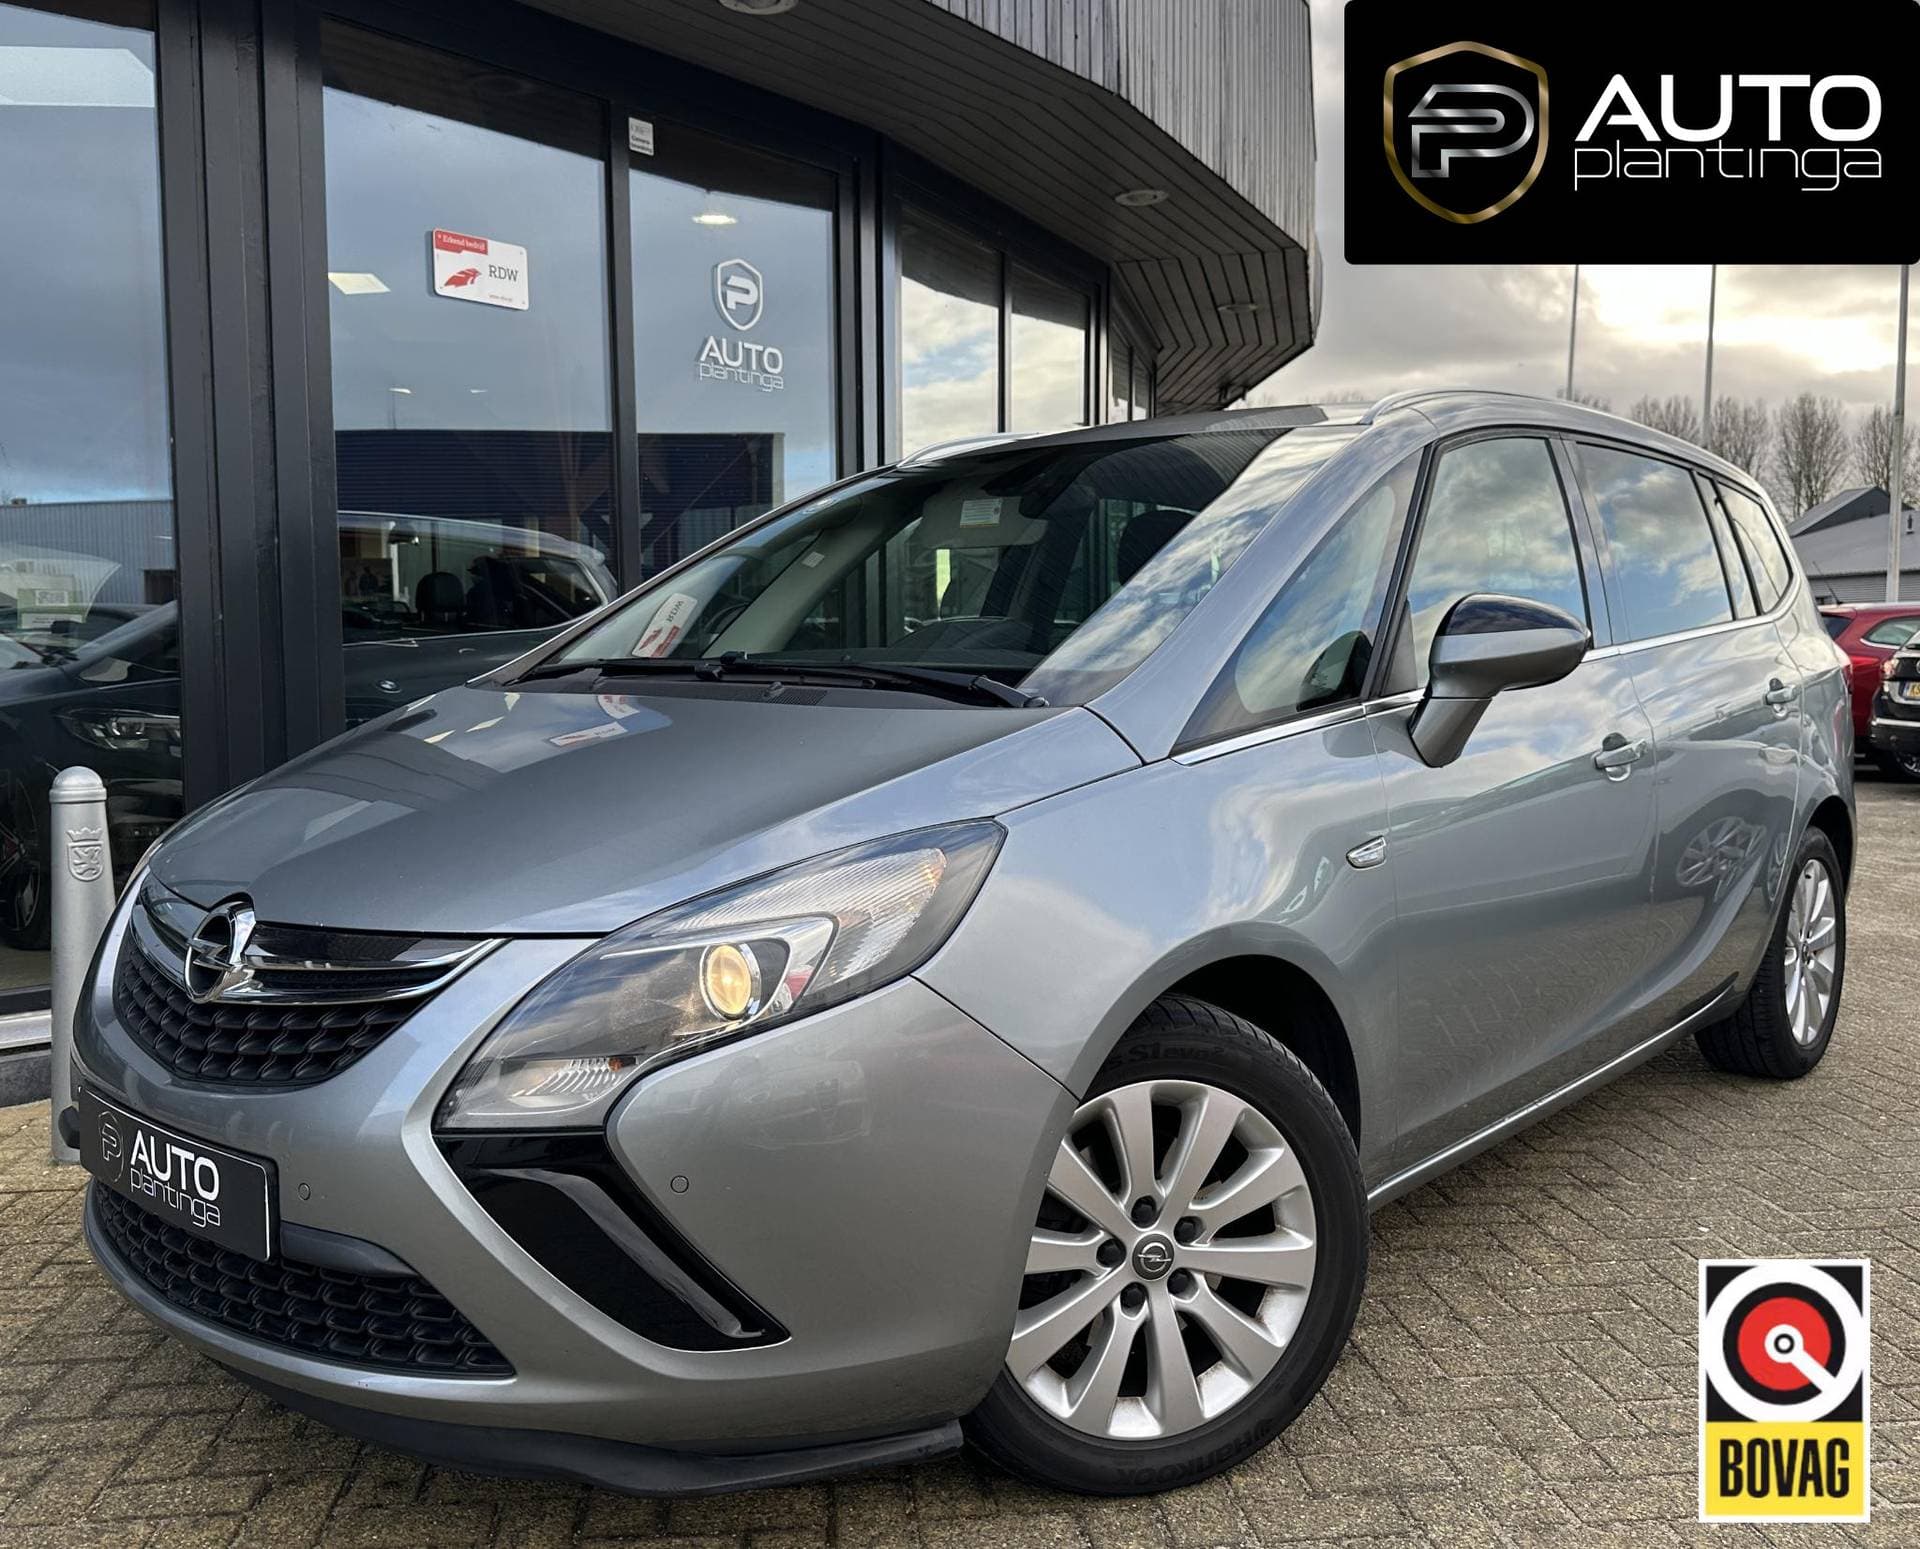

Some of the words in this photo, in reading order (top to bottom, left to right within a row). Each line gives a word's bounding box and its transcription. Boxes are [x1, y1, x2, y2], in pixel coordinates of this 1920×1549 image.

[488, 264, 519, 282] RDW
[700, 335, 783, 375] AUTO
[699, 361, 784, 393] plantinga
[130, 1129, 220, 1201] AUTO
[129, 1167, 221, 1229] plantinga
